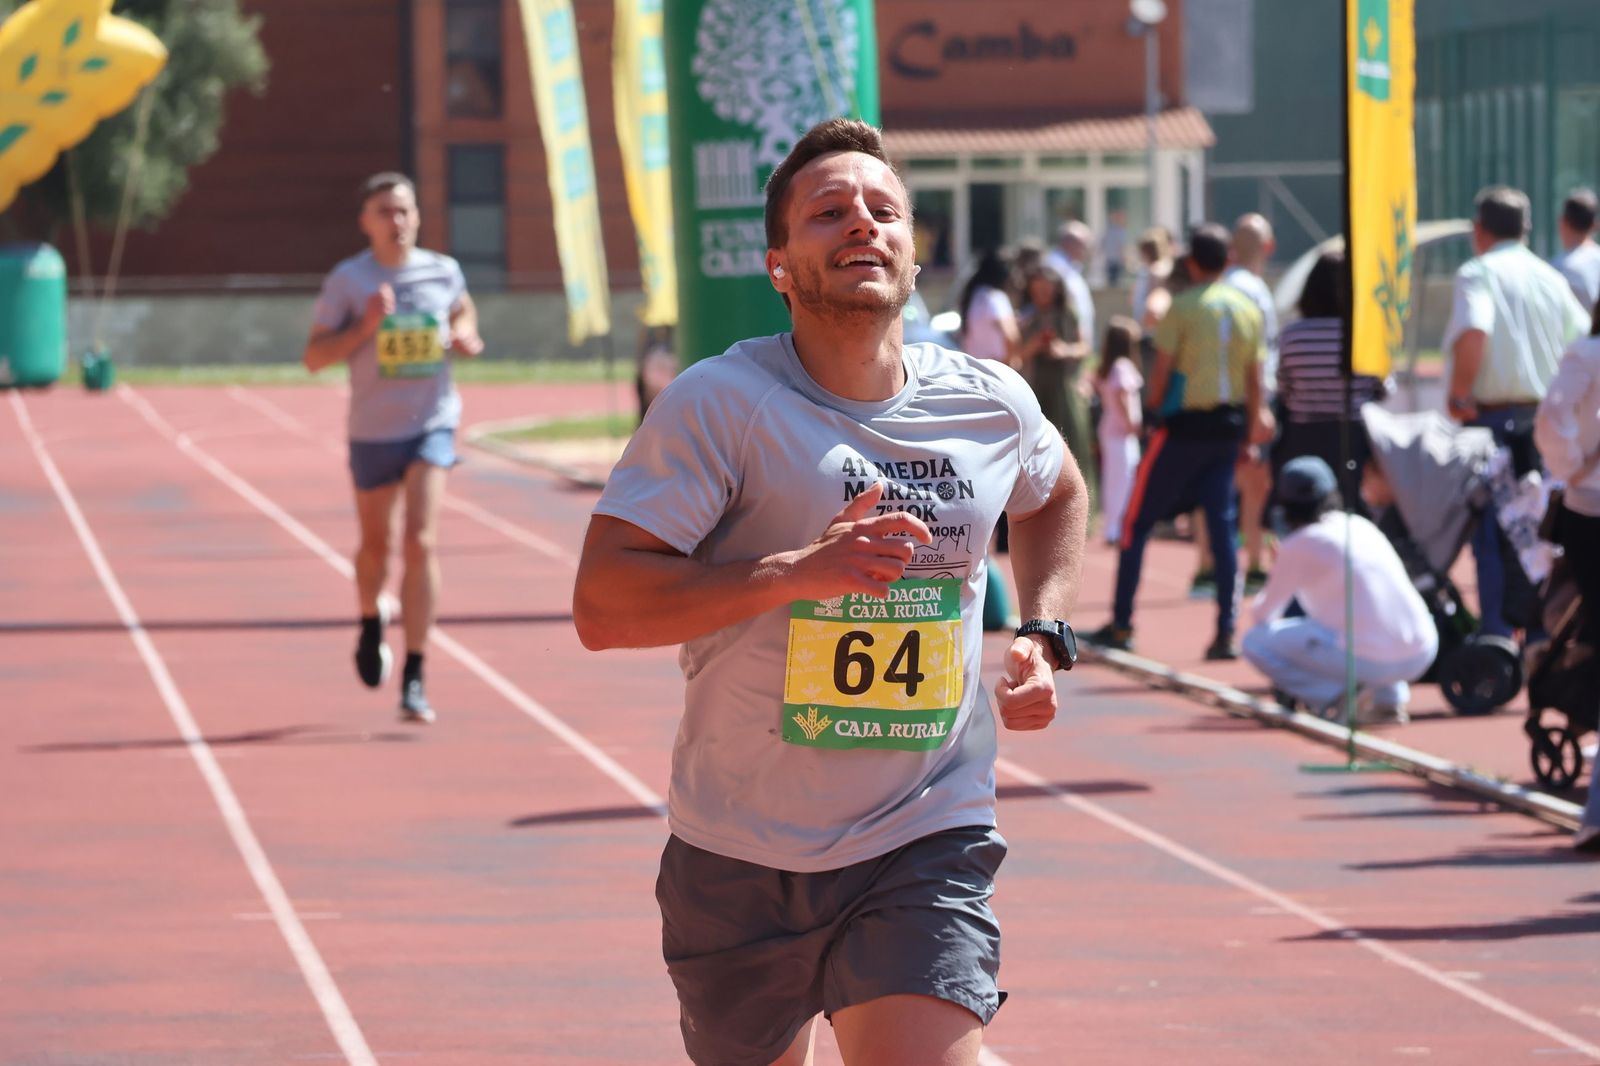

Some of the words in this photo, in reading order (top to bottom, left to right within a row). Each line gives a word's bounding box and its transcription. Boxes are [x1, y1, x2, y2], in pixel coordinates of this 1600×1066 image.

[874, 458, 957, 480] MEDIA
[920, 554, 945, 564] 2026
[849, 604, 889, 619] CAJA
[893, 602, 943, 619] RURAL
[833, 629, 925, 698] 64
[834, 719, 883, 738] CAJA
[887, 720, 948, 740] RURAL
